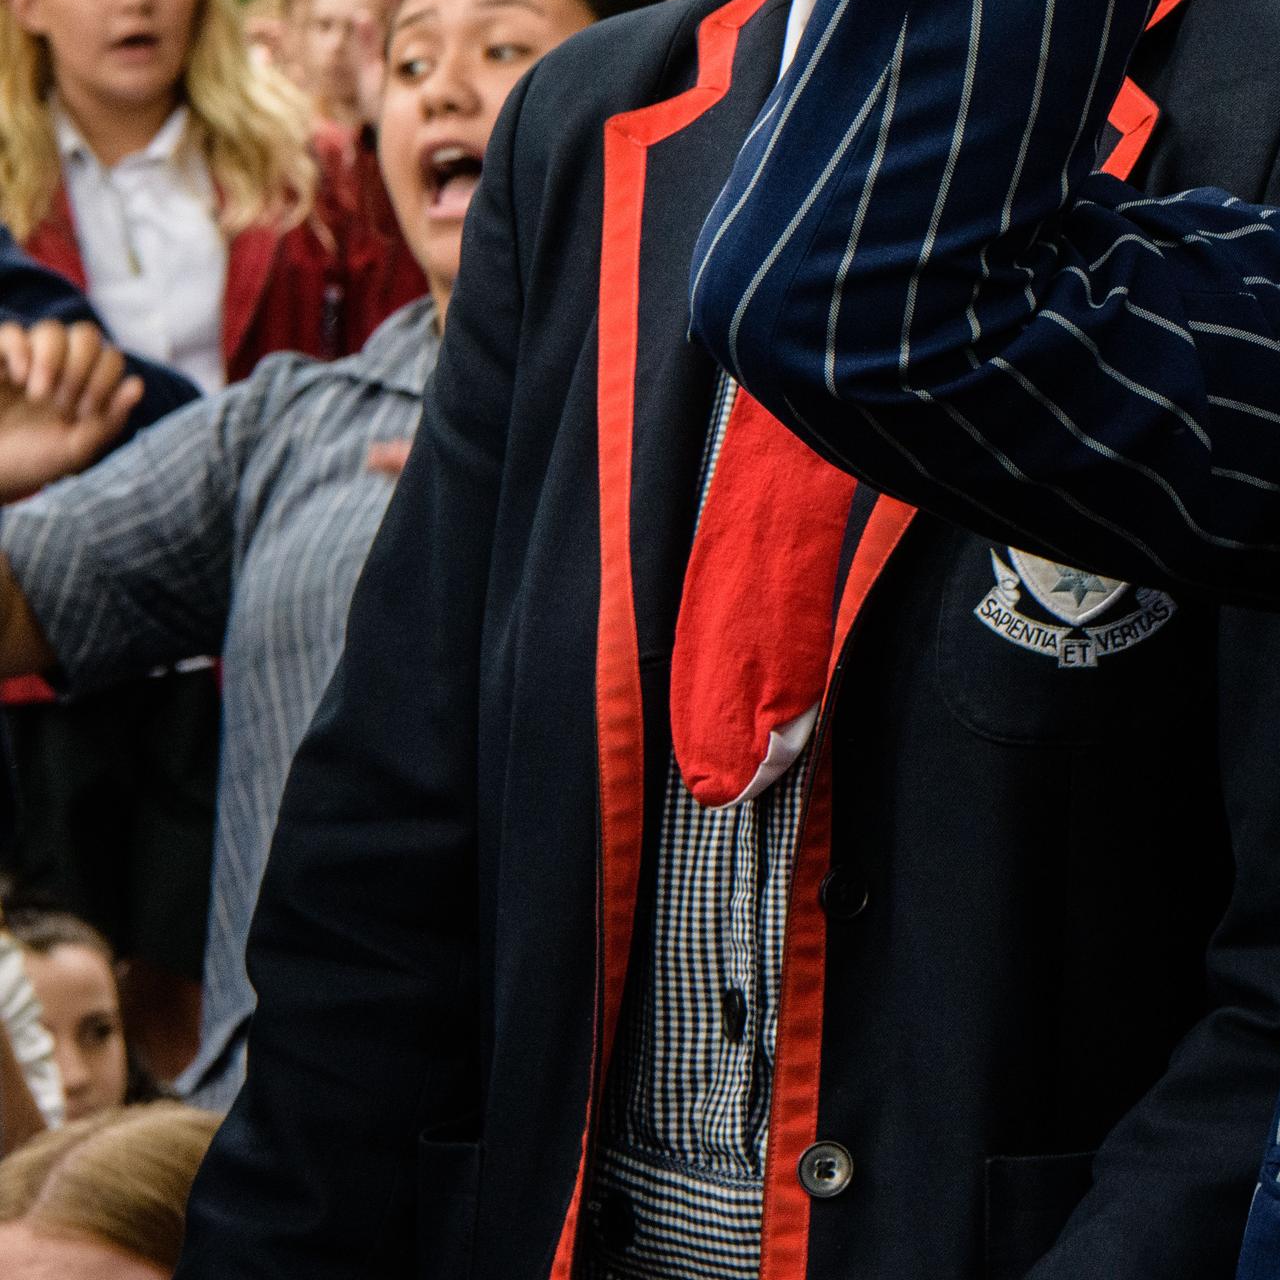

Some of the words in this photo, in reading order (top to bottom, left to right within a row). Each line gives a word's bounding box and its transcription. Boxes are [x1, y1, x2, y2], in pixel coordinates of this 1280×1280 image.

[980, 598, 1058, 650] SAPIENTIA
[1063, 644, 1091, 664] ET
[1095, 600, 1170, 652] VERITAS
